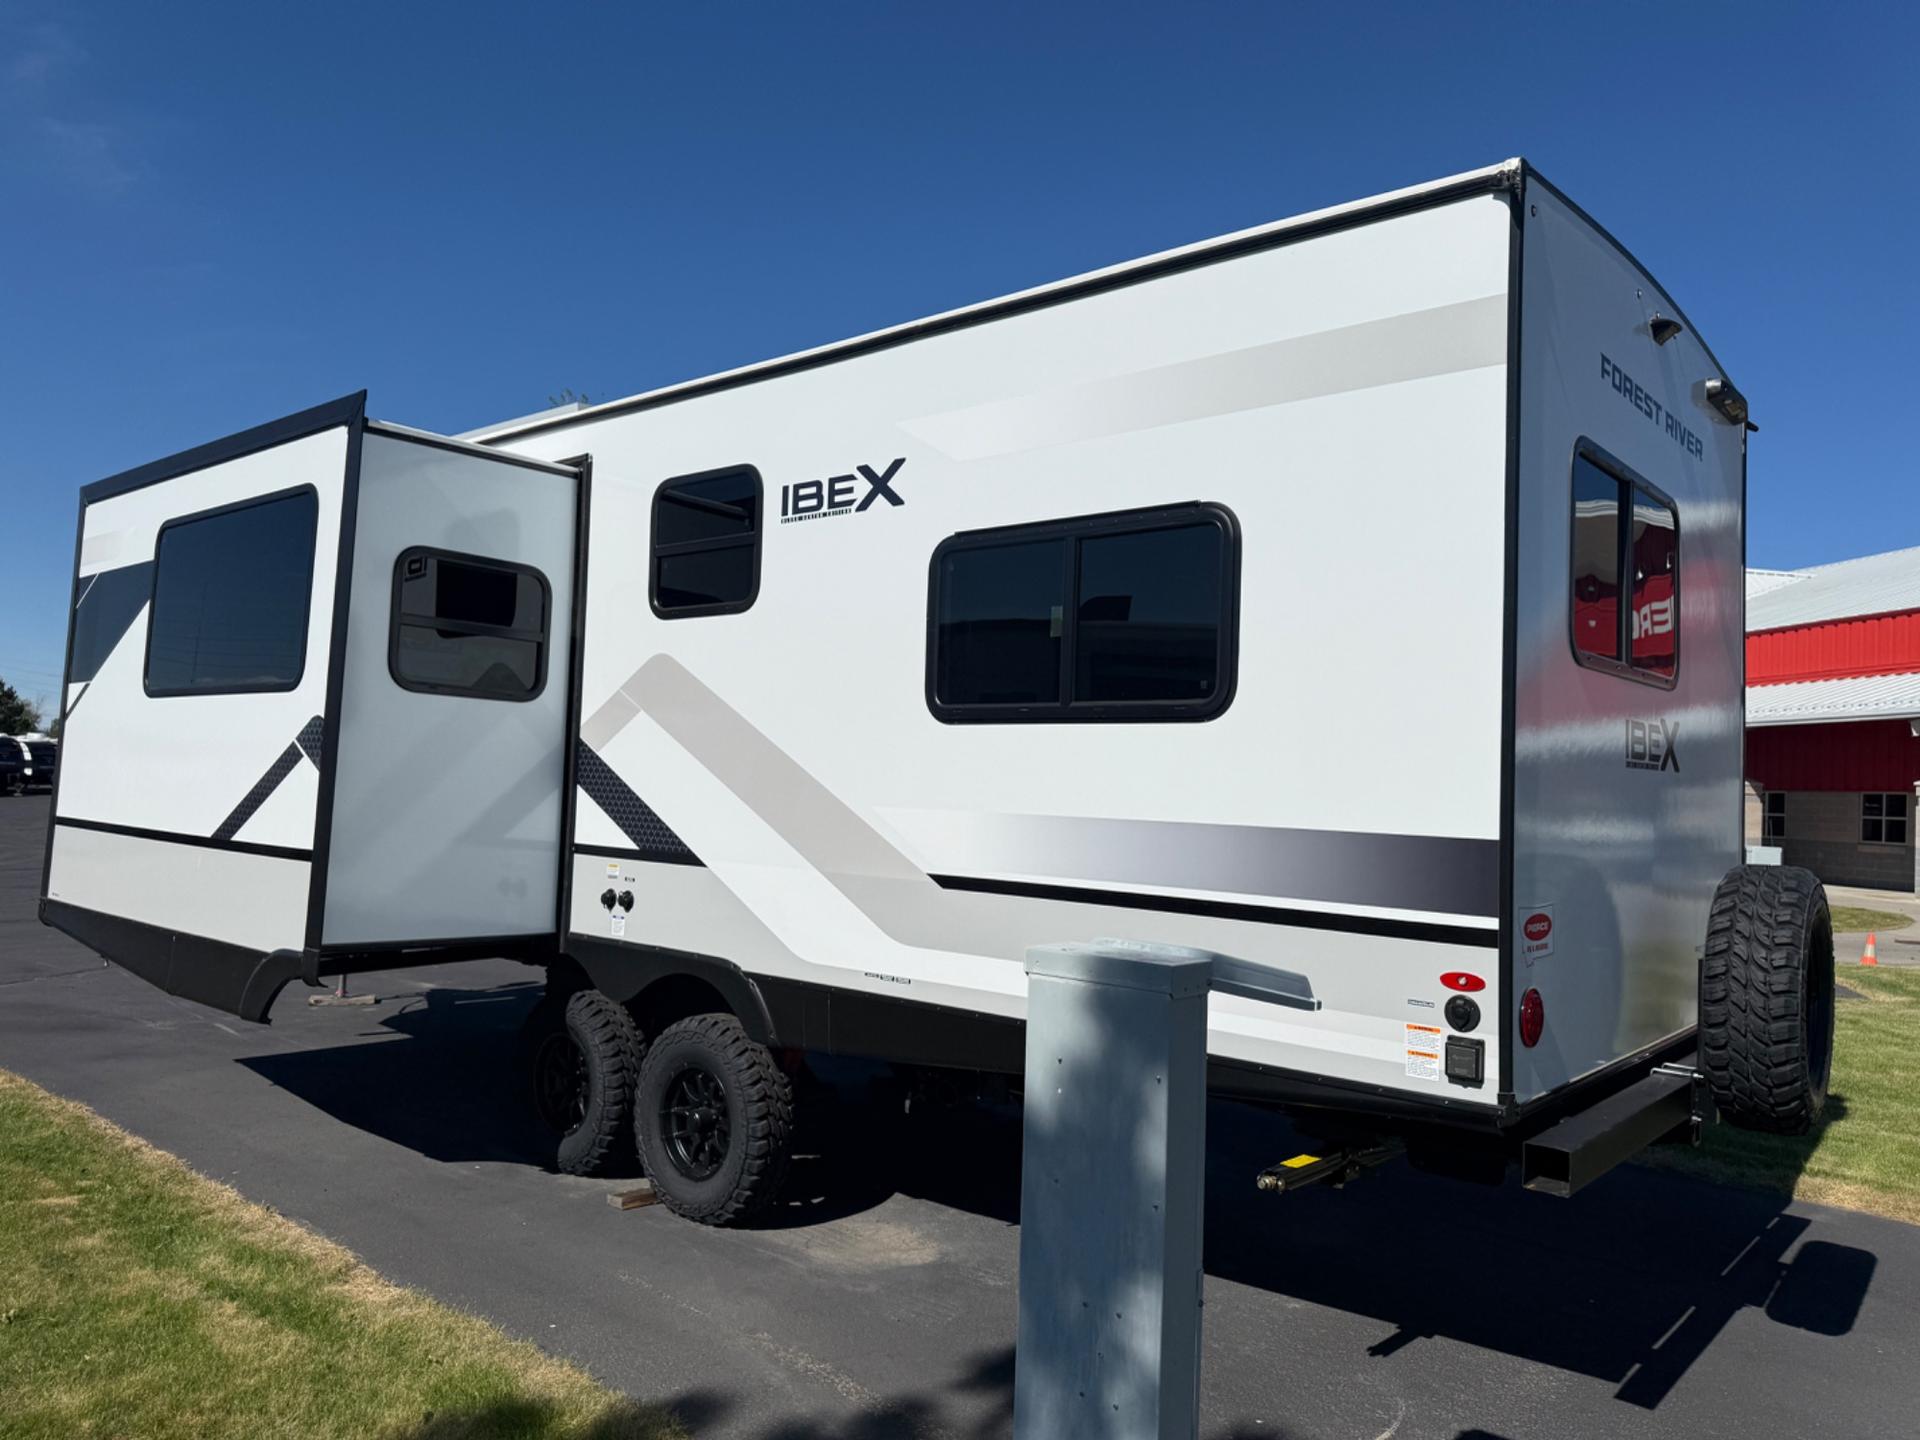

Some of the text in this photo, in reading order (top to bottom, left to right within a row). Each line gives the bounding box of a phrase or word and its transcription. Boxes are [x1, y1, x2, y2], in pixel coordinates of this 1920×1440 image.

[1600, 352, 1704, 462] FOREST RIVER
[781, 457, 906, 517] IBEX
[1625, 718, 1680, 773] IBEX
